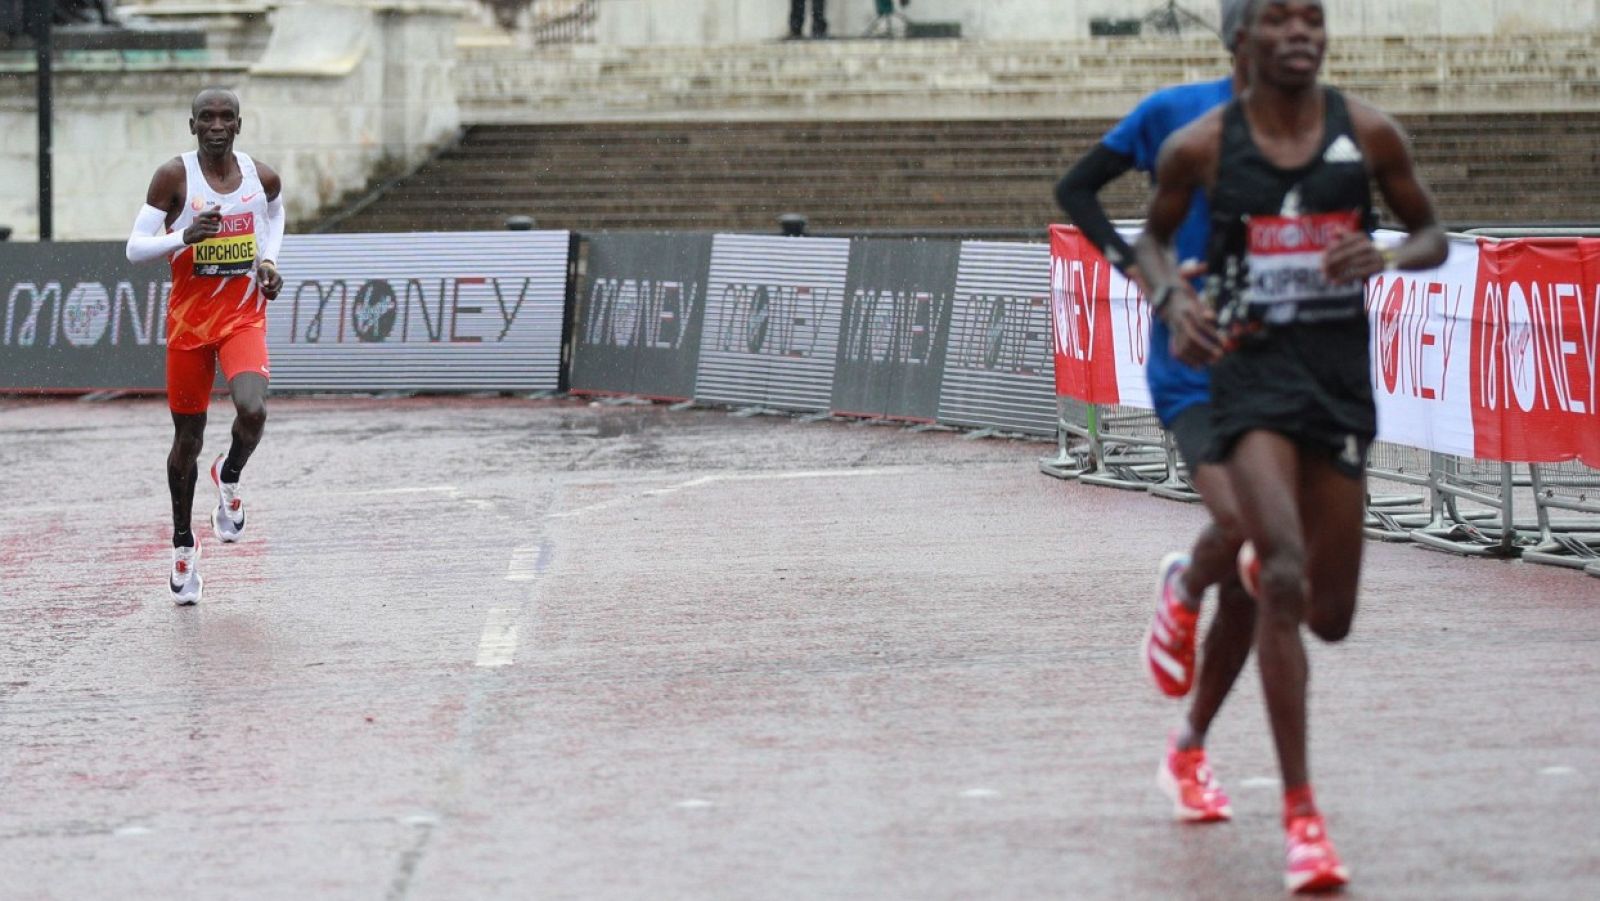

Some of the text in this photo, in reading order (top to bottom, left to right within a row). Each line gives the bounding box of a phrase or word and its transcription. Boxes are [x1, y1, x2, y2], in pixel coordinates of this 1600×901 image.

[196, 241, 254, 261] KIPCHOGE
[214, 217, 252, 234] NEY
[1250, 217, 1355, 249] MONE
[3, 281, 174, 346] MON
[289, 277, 530, 343] MONEY
[585, 277, 698, 350] MONEY
[716, 283, 829, 358] MONEY
[844, 289, 945, 365] MONEY
[1480, 280, 1600, 415] MONEY
